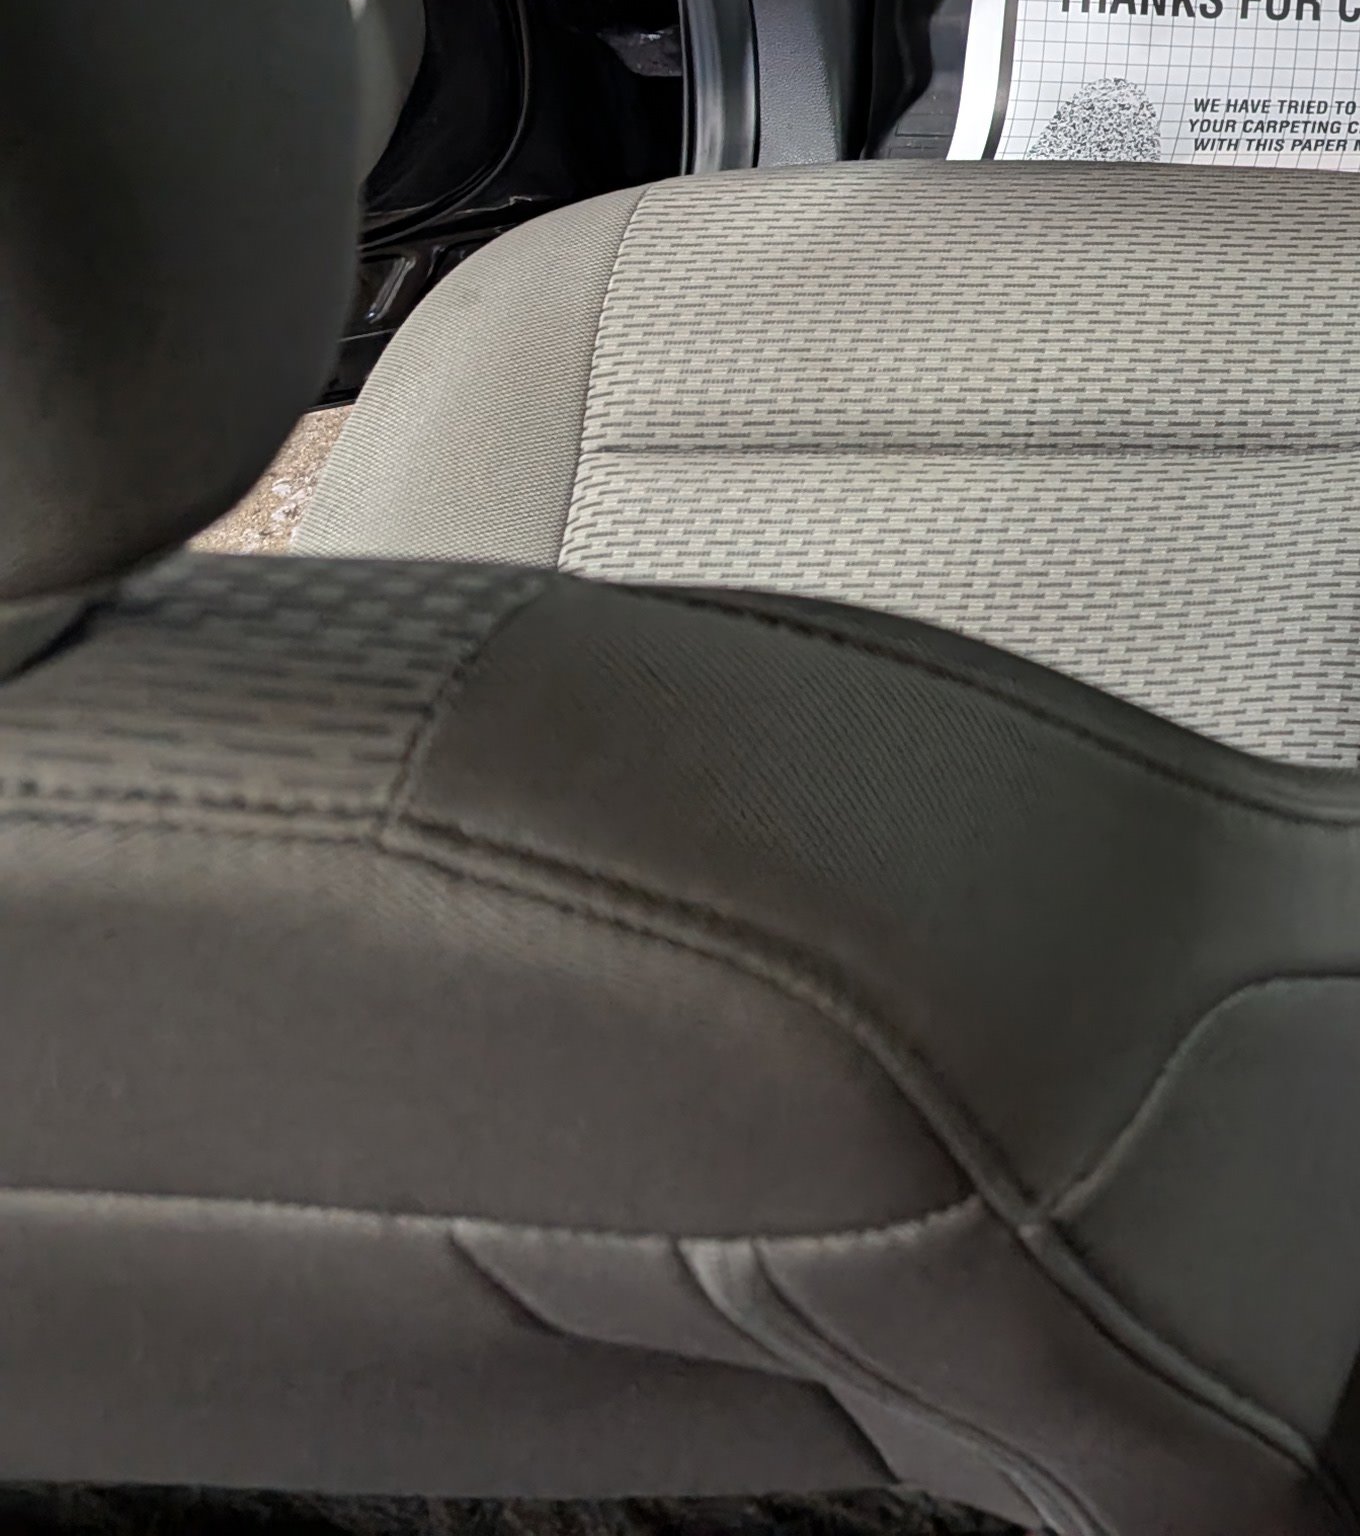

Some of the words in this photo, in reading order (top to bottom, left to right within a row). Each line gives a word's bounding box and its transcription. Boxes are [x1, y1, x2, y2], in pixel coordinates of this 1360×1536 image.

[1194, 98, 1221, 113] WE
[1225, 99, 1272, 114] HAVE
[1277, 100, 1328, 115] TRIED
[1335, 101, 1356, 115] TO
[1189, 119, 1237, 133] YOUR
[1242, 120, 1342, 134] CARPETING
[1194, 138, 1240, 152] WITH
[1245, 138, 1285, 152] THIS
[1290, 139, 1348, 152] PAPER
